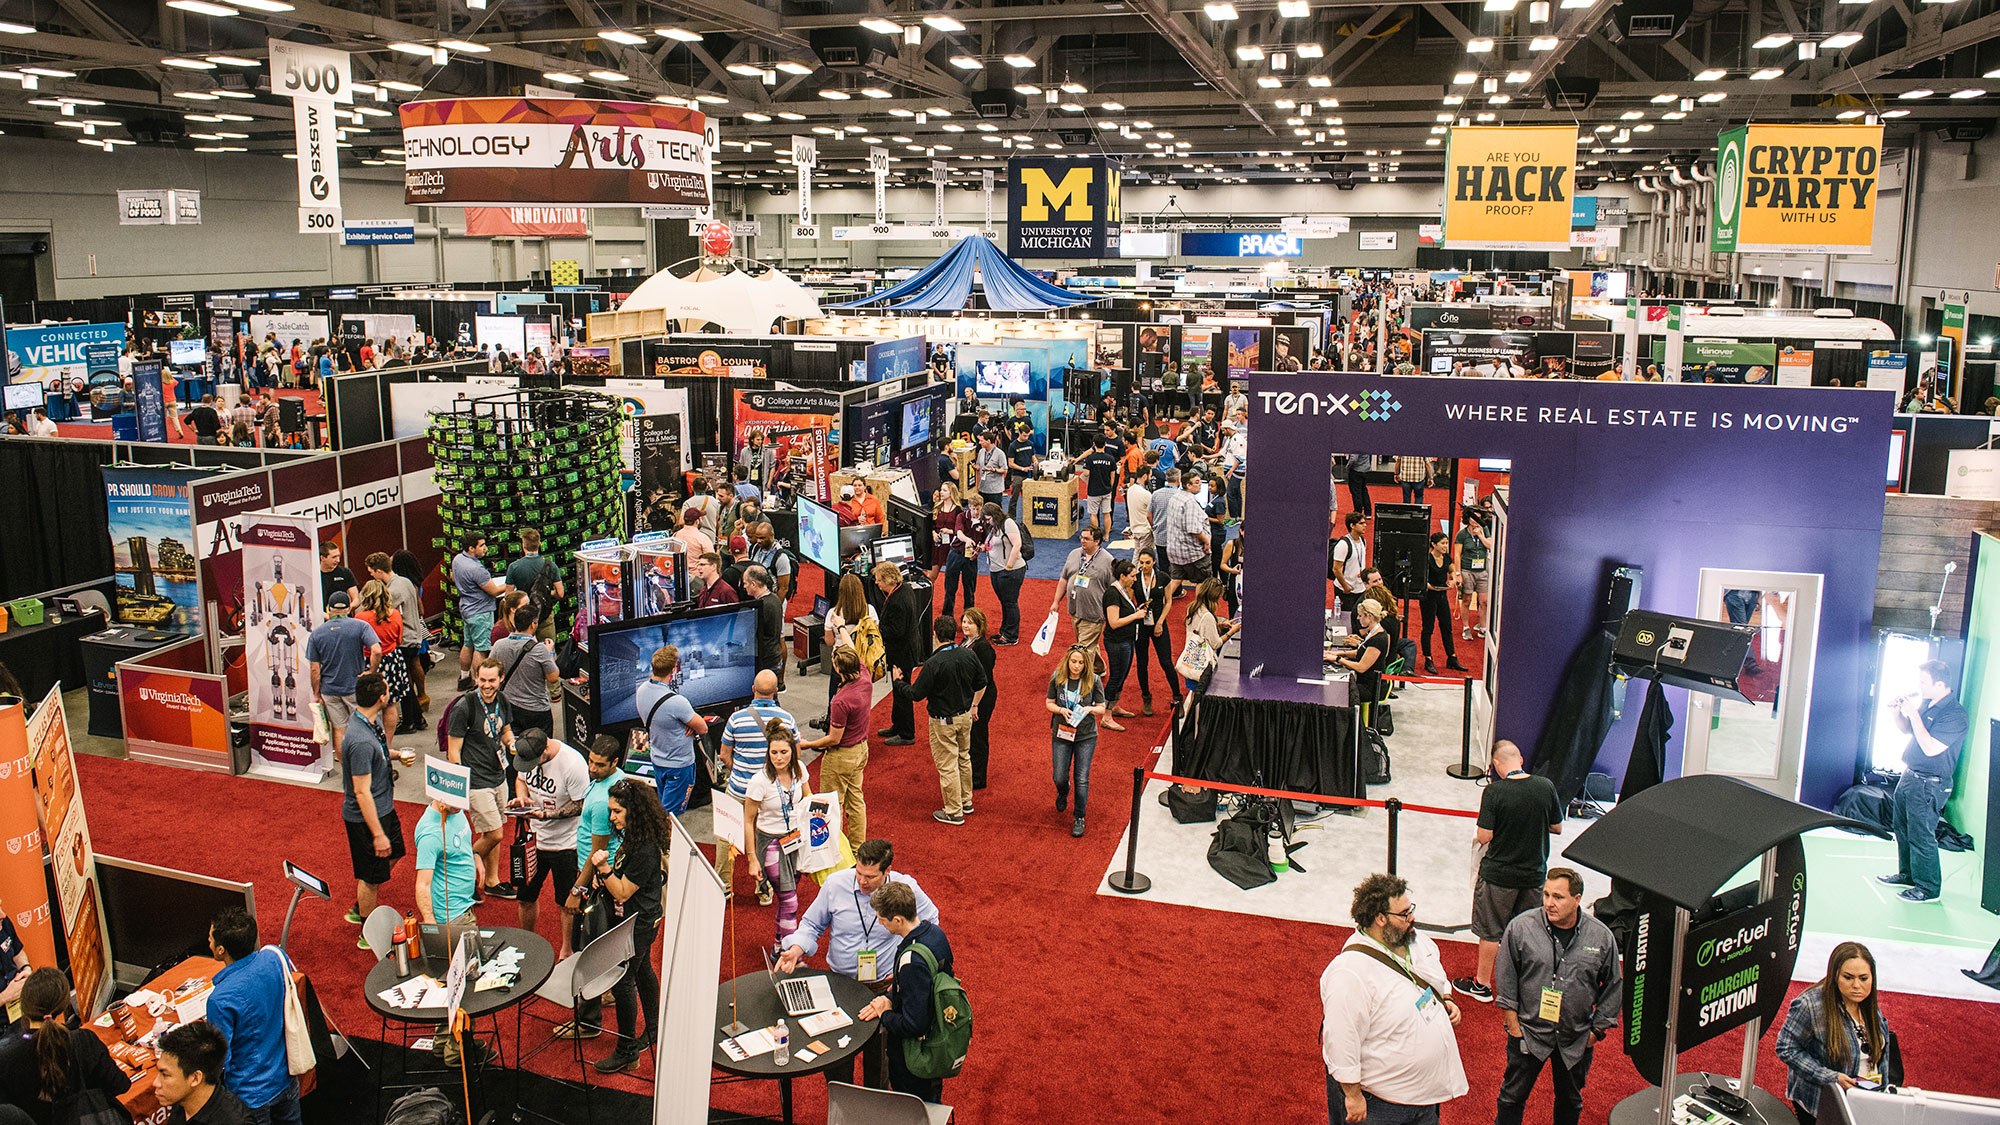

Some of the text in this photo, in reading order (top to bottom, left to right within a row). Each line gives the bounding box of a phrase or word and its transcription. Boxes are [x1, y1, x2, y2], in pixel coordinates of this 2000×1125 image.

[285, 58, 340, 95] 500
[307, 106, 322, 167] SXSW
[553, 125, 646, 170] Arts
[796, 145, 814, 163] 800
[873, 155, 887, 170] 900
[1486, 152, 1541, 162] ARE YOU
[1749, 145, 1877, 175] CRYPTO
[1455, 166, 1567, 202] HACK
[1021, 168, 1093, 221] M
[1107, 168, 1121, 222] M
[1745, 177, 1875, 209] PARTY
[130, 200, 161, 209] FUTURE
[1486, 205, 1534, 216] PROOF?
[129, 209, 161, 217] OF FOOD
[1780, 212, 1837, 223] WITH US
[307, 215, 335, 229] 500
[797, 228, 815, 236] 800
[873, 225, 889, 234] 900
[932, 230, 949, 238] 1000
[1021, 227, 1093, 236] UNIVERSITY OF
[346, 232, 414, 241] Exhibitor Service Center
[1020, 237, 1093, 249] MICHIGAN
[1239, 234, 1301, 257] BRASIL
[40, 330, 108, 342] CONNECTED
[25, 340, 123, 365] VEHICS
[1697, 347, 1734, 355] Hanover
[657, 356, 762, 368] BASTROP COUNTY
[767, 396, 794, 406] College
[795, 397, 803, 405] of
[803, 397, 818, 405] Arts
[1445, 404, 1528, 422] WHERE
[1538, 407, 1598, 425] REAL
[1608, 409, 1698, 428] ESTATE
[1712, 412, 1733, 428] IS
[633, 418, 642, 449] Denver
[643, 436, 655, 444] Arts
[661, 434, 678, 443] Media
[644, 430, 664, 440] College
[633, 452, 643, 486] Colorado
[815, 429, 827, 500] MIRROR WORLDS
[107, 483, 119, 497] PR
[119, 483, 151, 497] SHOULD
[152, 484, 176, 498] GROW
[211, 484, 262, 504] VirginiaTech
[635, 486, 642, 497] of
[229, 497, 241, 506] Invent
[1033, 501, 1058, 510] M city
[158, 507, 174, 515] YOUR
[262, 529, 295, 540] VirginiaTech
[149, 689, 202, 706] VirginiaTech
[265, 738, 308, 750] Application Specific
[278, 733, 300, 742] Humanoid
[262, 744, 312, 757] Protective Body Panels
[438, 775, 464, 790] TripRiff
[811, 826, 829, 839] ASA
[1788, 892, 1800, 951] re-fuel
[1630, 912, 1650, 1047] CHARGING STATION
[1700, 964, 1760, 1004] CHARGING
[1698, 983, 1758, 1028] STATION
